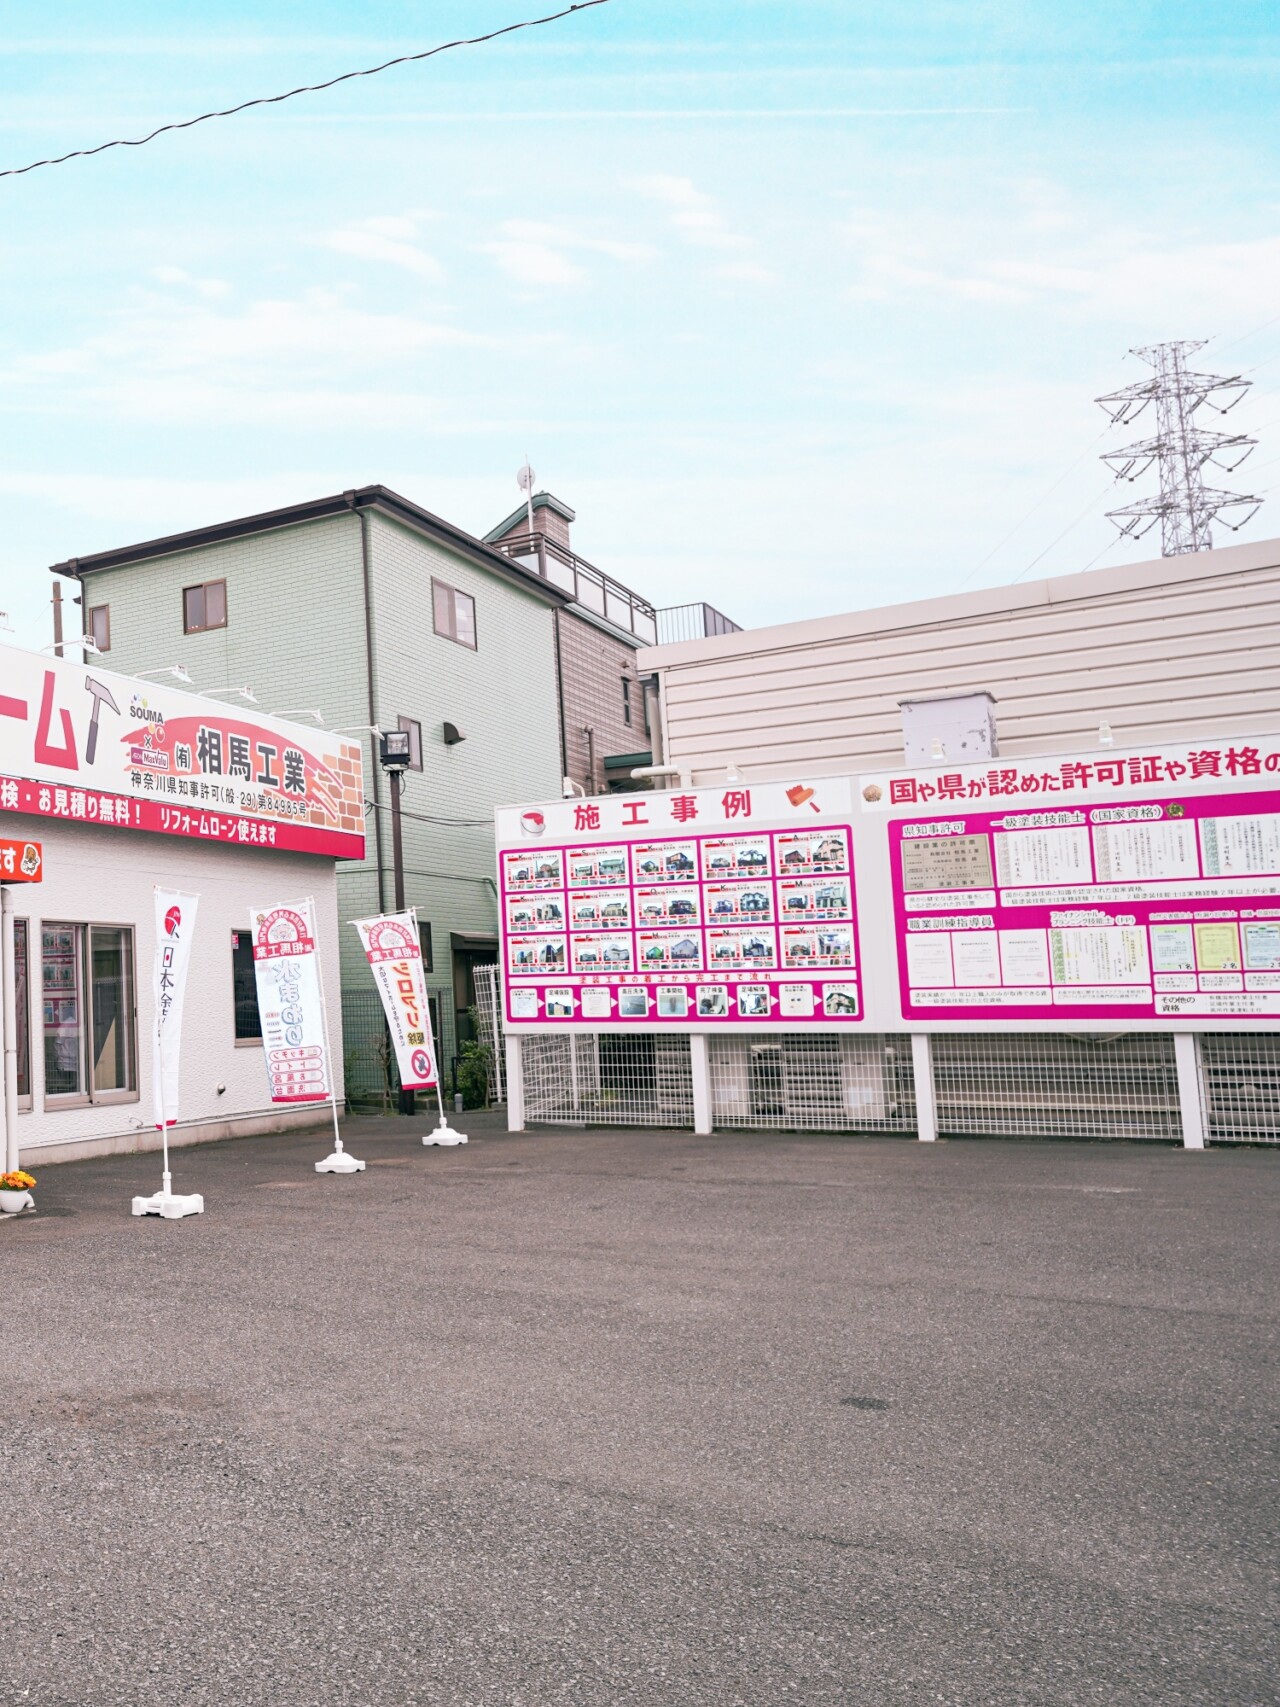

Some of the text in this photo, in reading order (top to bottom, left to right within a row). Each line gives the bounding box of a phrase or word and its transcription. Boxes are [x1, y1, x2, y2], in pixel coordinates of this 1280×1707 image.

[130, 705, 164, 724] SOUMA
[573, 789, 752, 832] 施工事例
[160, 808, 277, 845] リフォームローン使えます
[904, 822, 965, 836] 県知事許可
